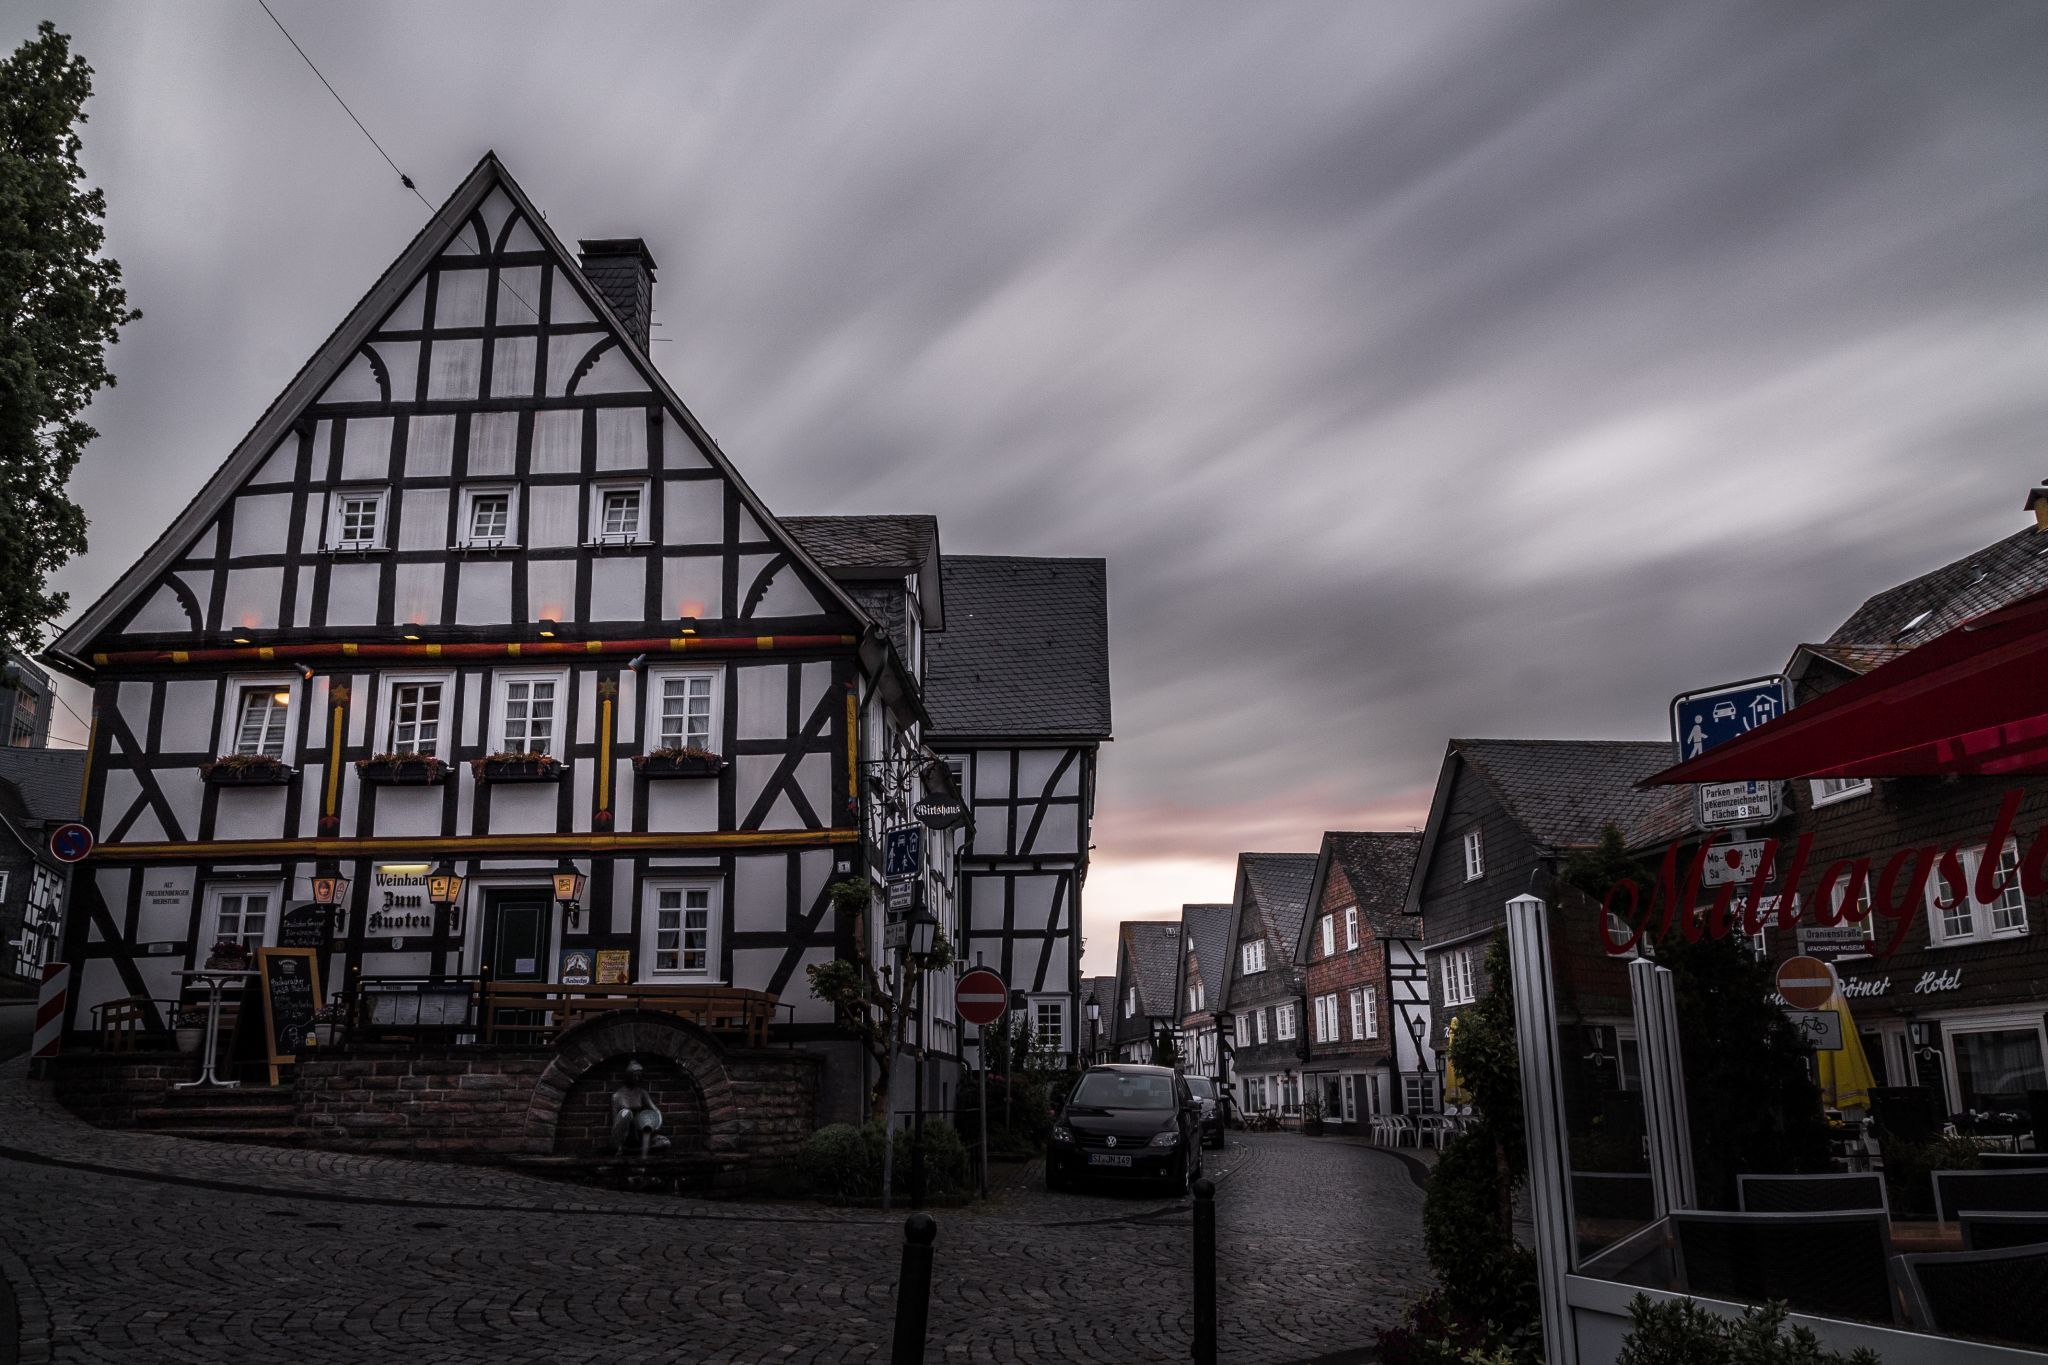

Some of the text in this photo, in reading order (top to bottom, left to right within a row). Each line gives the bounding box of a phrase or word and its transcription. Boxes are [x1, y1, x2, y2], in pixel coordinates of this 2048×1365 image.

[1706, 788, 1731, 798] Parken
[1733, 785, 1746, 795] mit
[916, 804, 961, 816] Wirtshaus
[1704, 795, 1768, 811] gekennzeichneten
[1711, 805, 1762, 819] Flächen 3 Std.
[1709, 868, 1720, 879] Sa
[382, 891, 421, 912] Zum
[368, 911, 431, 933] Knoten
[1806, 929, 1861, 938] Oranienstraße
[1914, 968, 1962, 995] Hotel
